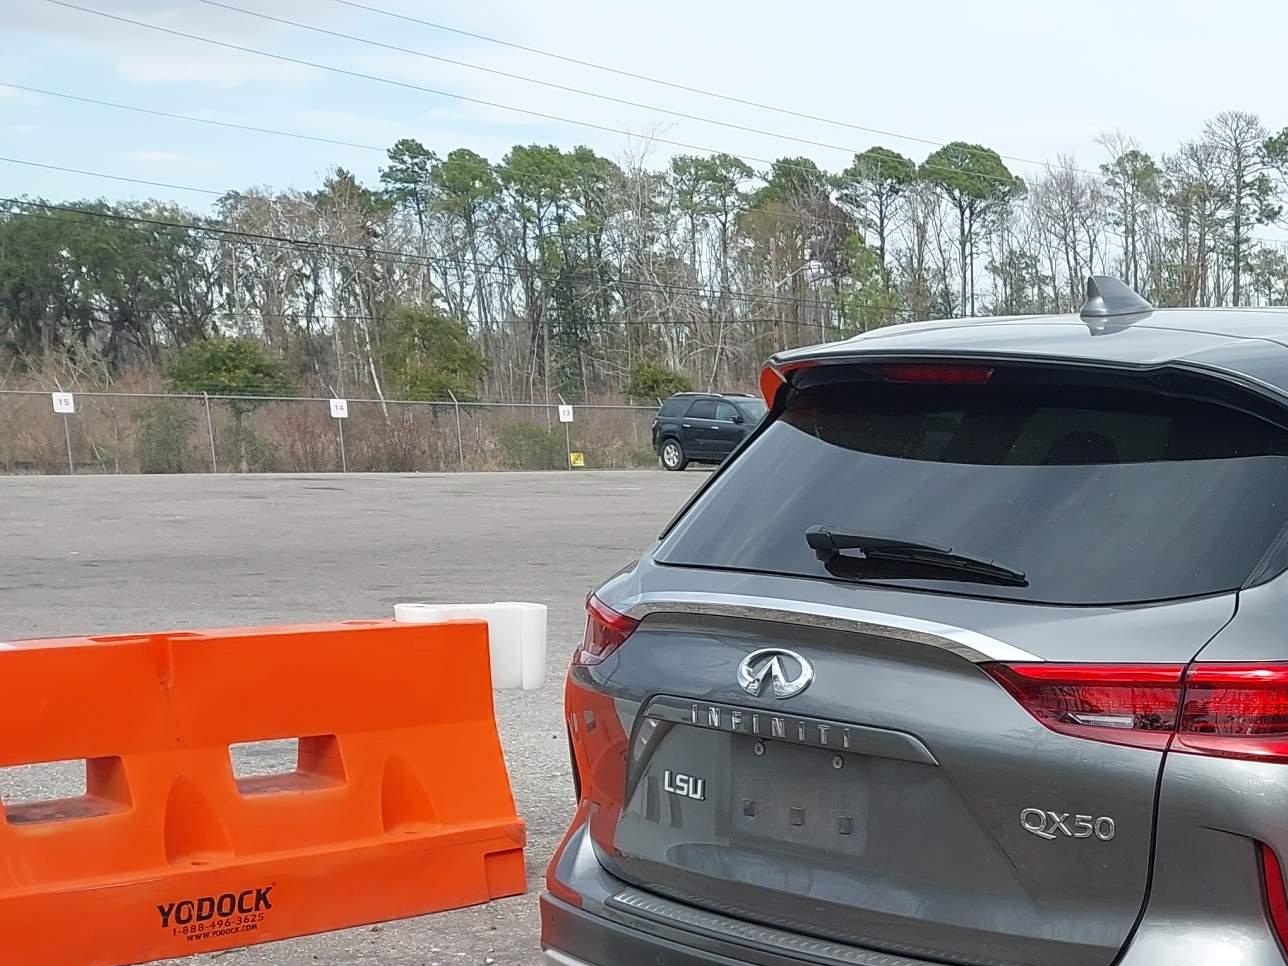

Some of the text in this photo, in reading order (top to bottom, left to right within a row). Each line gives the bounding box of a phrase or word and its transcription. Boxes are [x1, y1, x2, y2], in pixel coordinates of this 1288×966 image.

[58, 398, 70, 406] 15
[691, 704, 850, 748] INFINITI
[664, 770, 705, 800] LSU
[1020, 808, 1115, 840] QX50
[156, 886, 273, 928] YODOCK
[172, 912, 265, 937] 1-888-496-3625
[186, 924, 258, 942] WWW.YODOCK.COM
